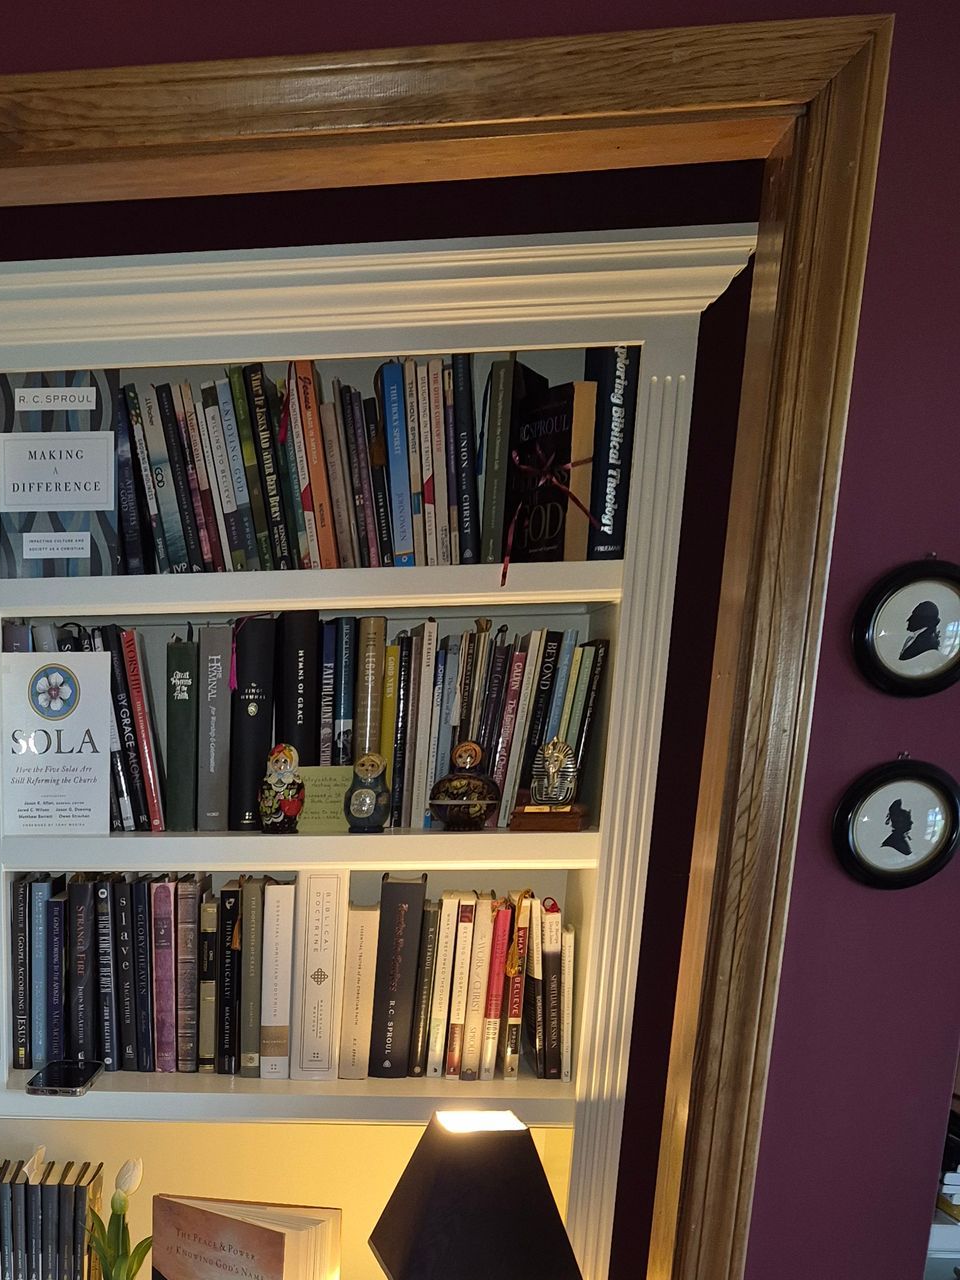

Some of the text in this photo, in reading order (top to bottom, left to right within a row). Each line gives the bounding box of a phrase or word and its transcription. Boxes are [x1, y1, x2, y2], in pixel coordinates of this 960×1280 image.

[18, 394, 92, 404] R. C. SPROUL
[407, 381, 418, 454] THE HOLY SPIRIT
[28, 450, 84, 460] MAKING
[607, 406, 624, 464] Biblical
[12, 481, 101, 493] DIFFERENCE
[154, 466, 166, 489] GOD
[234, 467, 244, 494] GOD
[459, 431, 472, 535] UNION CHRIST
[600, 468, 621, 535] Theology
[173, 562, 188, 573] IVP
[125, 638, 140, 694] WORSHIP
[297, 649, 305, 680] HYMNS
[364, 652, 376, 688] LEGACY
[539, 642, 558, 690] BEYOND
[297, 683, 304, 693] OF
[322, 662, 334, 723] FAITH ALONE
[507, 662, 523, 713] CALVIN The
[12, 728, 100, 755] SOLA
[117, 693, 143, 789] BY GRACE ALONE
[27, 777, 59, 785] Reforming
[61, 765, 78, 773] Solas
[76, 905, 86, 976] STRANGE FIRE
[119, 897, 130, 971] slave
[225, 920, 233, 948] THINK
[313, 892, 321, 953] DOCTRINE
[323, 892, 332, 952] BIBLICAL
[98, 915, 112, 993] HIGH KING OF HEAVEN
[137, 914, 146, 995] GLORY HEAVEN
[511, 929, 525, 1016] WHAT BELIEVE
[457, 971, 465, 998] GOSPEL
[471, 940, 485, 1013] WORK CHRIST
[16, 1015, 27, 1043] JESUS
[384, 1000, 396, 1055] R.C. SPROUL
[549, 1008, 559, 1049] DEPRESSION
[175, 1227, 255, 1262] THE PEACE & POWER
[176, 1247, 214, 1265] KNOWING
[215, 1259, 239, 1274] GOD'S
